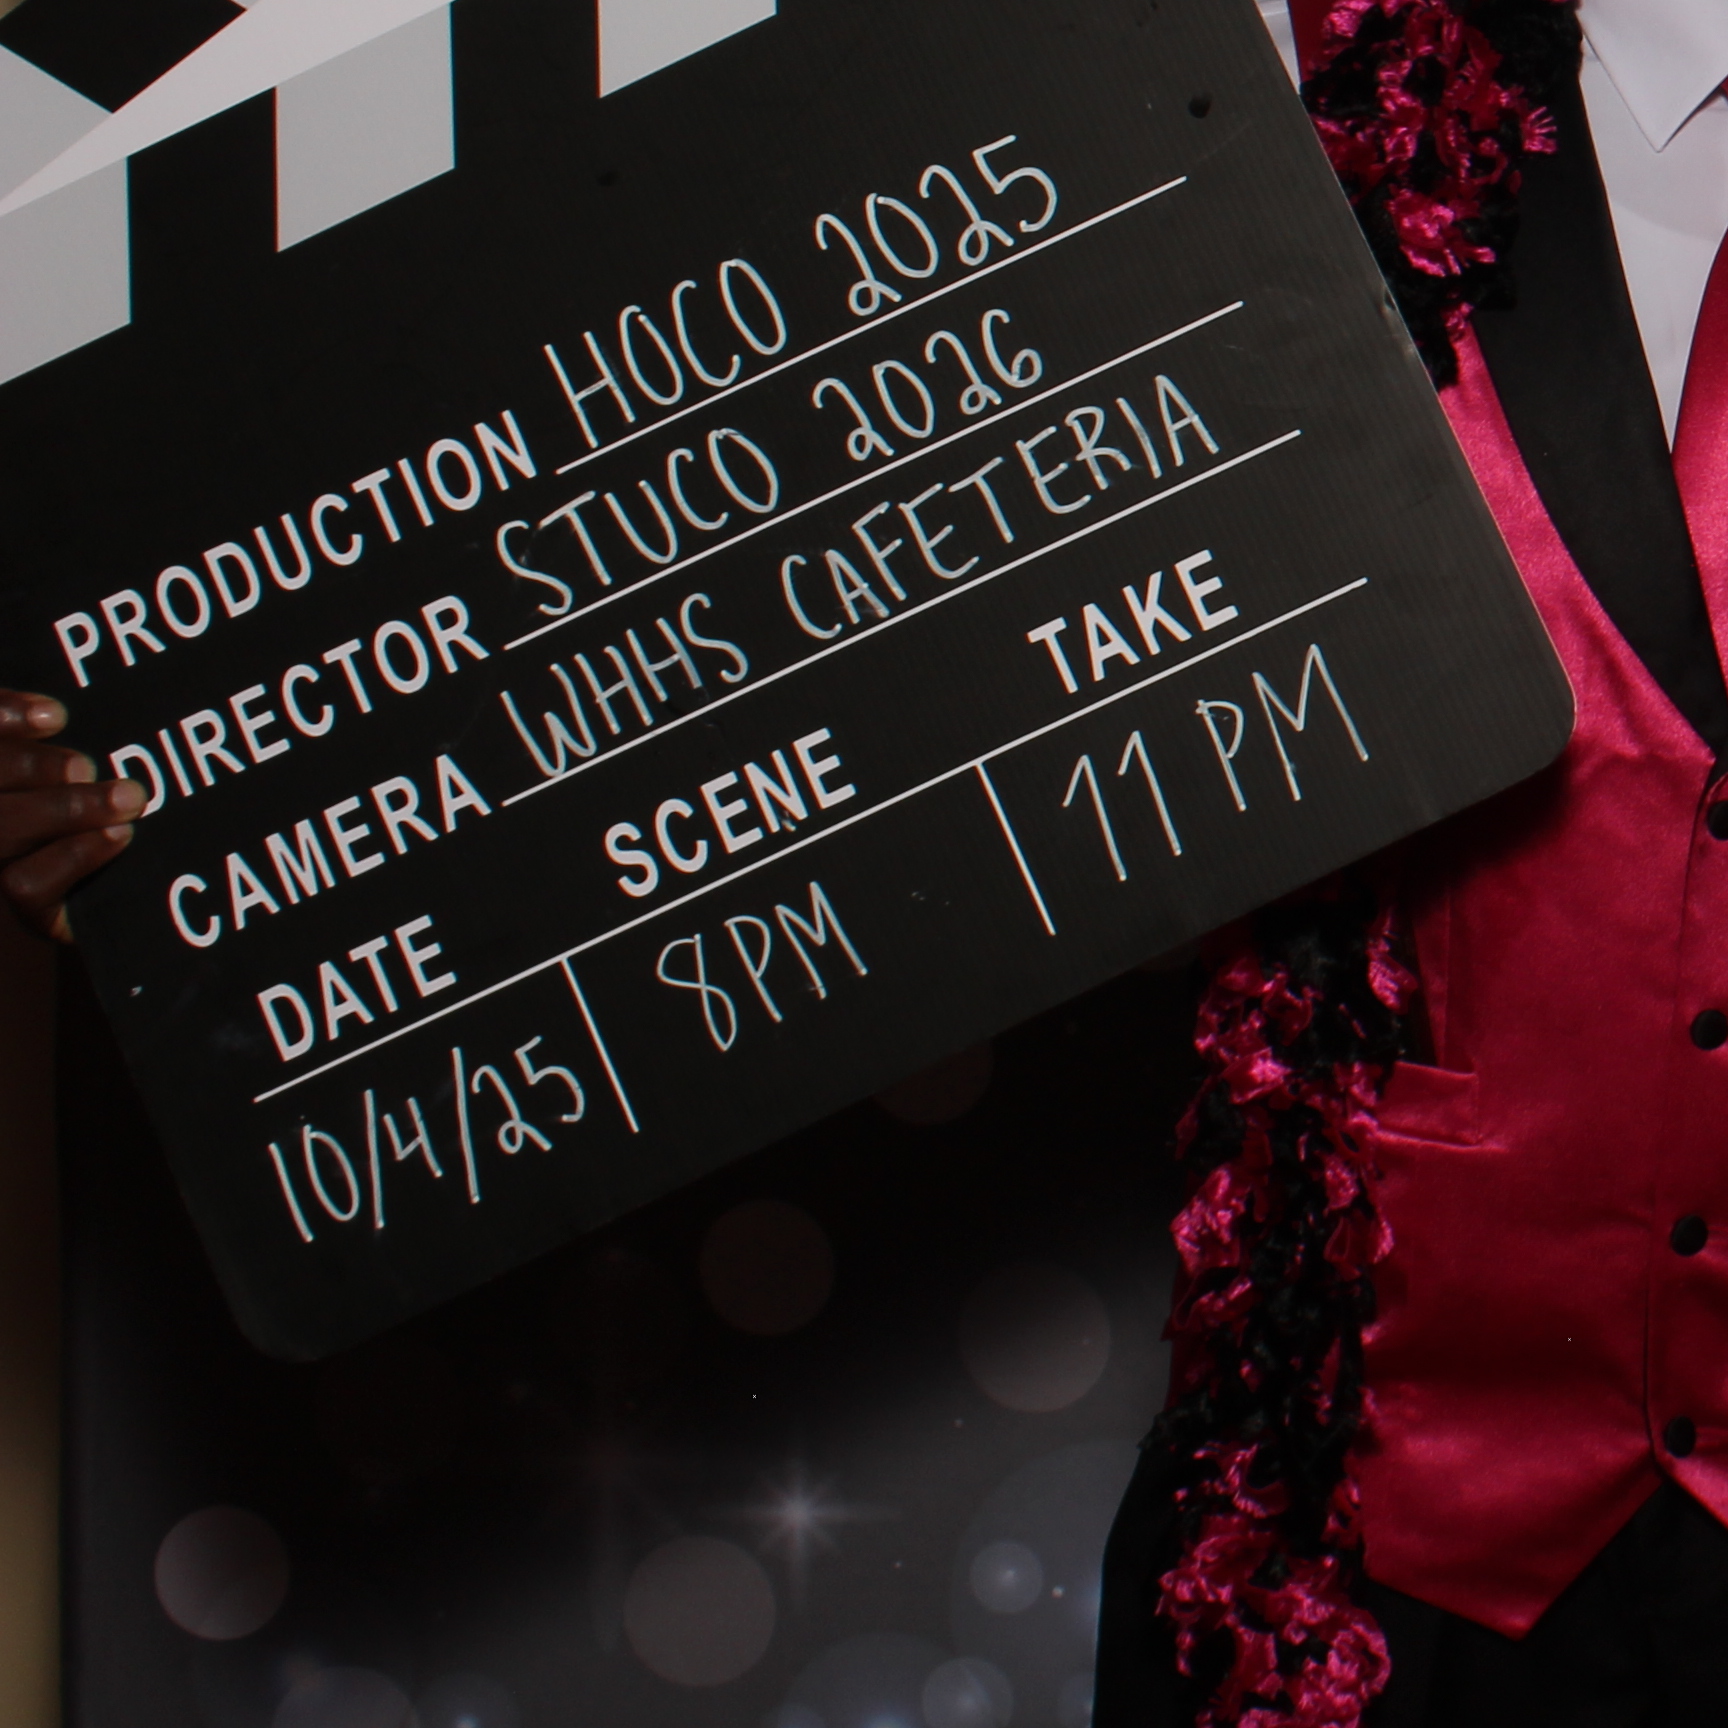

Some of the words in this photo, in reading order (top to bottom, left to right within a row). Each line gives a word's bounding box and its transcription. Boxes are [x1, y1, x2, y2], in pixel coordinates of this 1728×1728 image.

[54, 409, 537, 688] PRODUCTION
[543, 258, 787, 449] HOCO
[815, 134, 1058, 317] 2025
[109, 595, 490, 818] DIRECTOR
[496, 427, 779, 616] STUCO
[812, 308, 1043, 461] 2026
[169, 754, 492, 948] CAMERA
[499, 593, 749, 780] WHHS
[781, 374, 1220, 640] CAFETERIA
[257, 914, 457, 1062] DATE
[604, 727, 856, 898] SCENE
[1026, 549, 1239, 694] TAKE
[268, 1035, 585, 1243] 10/4/25
[656, 881, 868, 1052] 8PM
